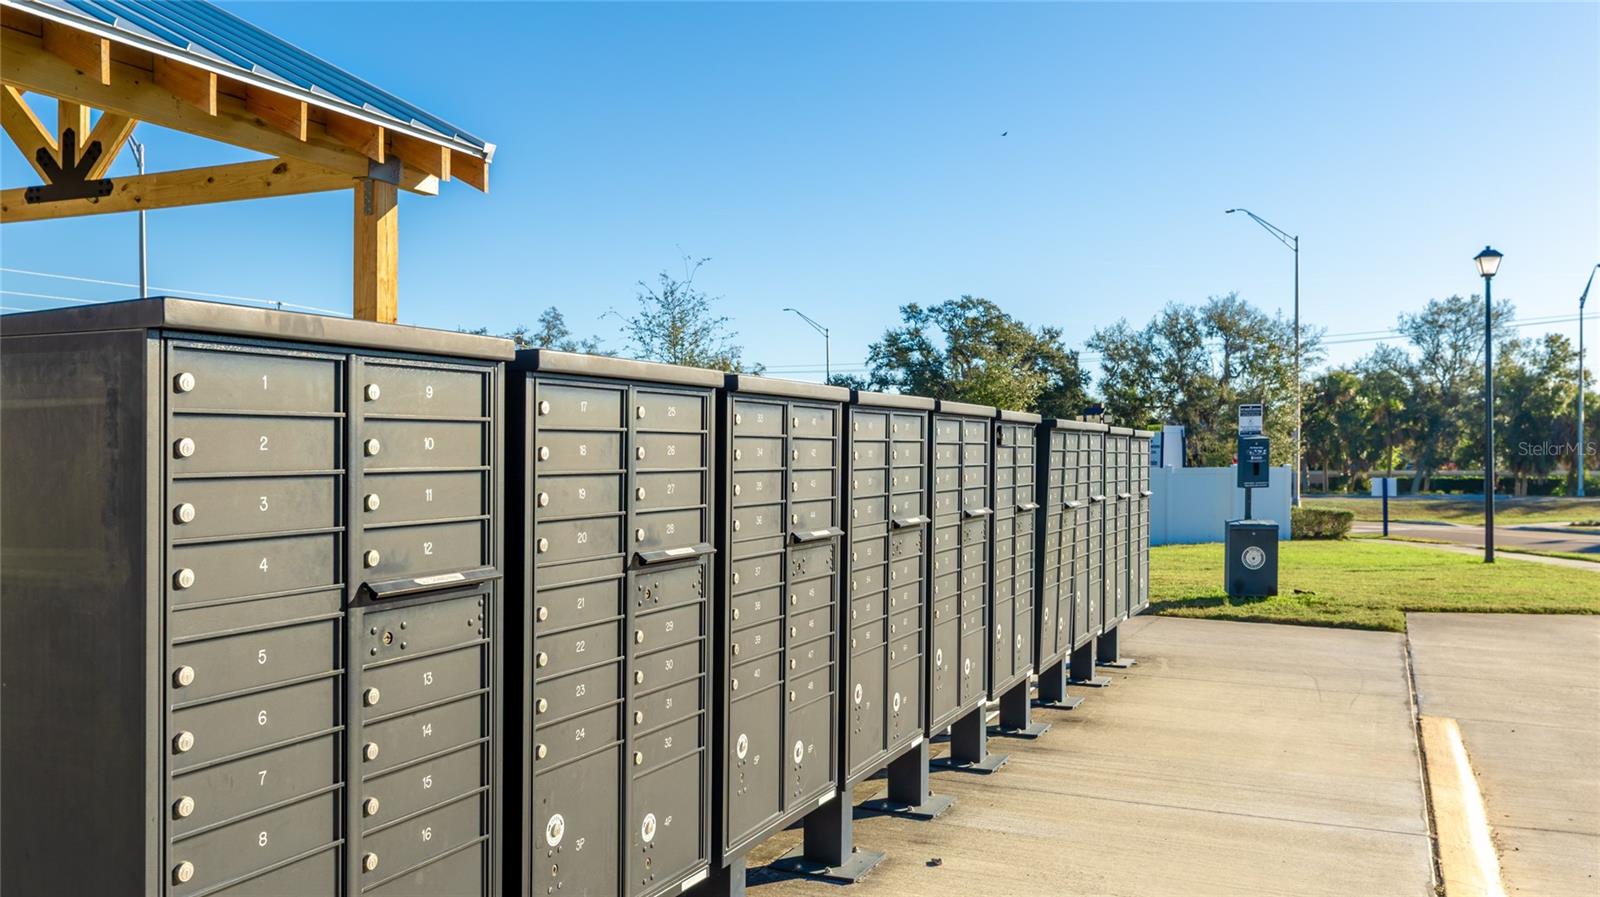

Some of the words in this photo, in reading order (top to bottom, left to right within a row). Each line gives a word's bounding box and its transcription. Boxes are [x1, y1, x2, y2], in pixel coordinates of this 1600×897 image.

[261, 374, 268, 390] 1
[425, 385, 434, 399] 9
[259, 435, 269, 451] 2
[423, 437, 435, 451] 10
[666, 444, 676, 456] 26
[425, 488, 433, 502] 11
[578, 487, 586, 500] 19
[666, 483, 676, 495] 27
[259, 496, 269, 512] 3
[577, 531, 588, 544] 20
[423, 541, 433, 555] 12
[258, 557, 269, 573] 4
[577, 597, 585, 609] 21
[665, 620, 674, 632] 29
[575, 640, 586, 653] 22
[257, 648, 267, 665] 5
[665, 658, 674, 671] 30
[423, 671, 433, 686] 13
[575, 683, 586, 697] 23
[665, 697, 673, 709] 31
[257, 709, 268, 726] 6
[422, 723, 433, 738] 14
[575, 727, 586, 741] 24
[664, 736, 673, 749] 32
[258, 769, 268, 786] 7
[422, 774, 433, 790] 15
[258, 831, 268, 847] 8
[421, 826, 432, 842] 16
